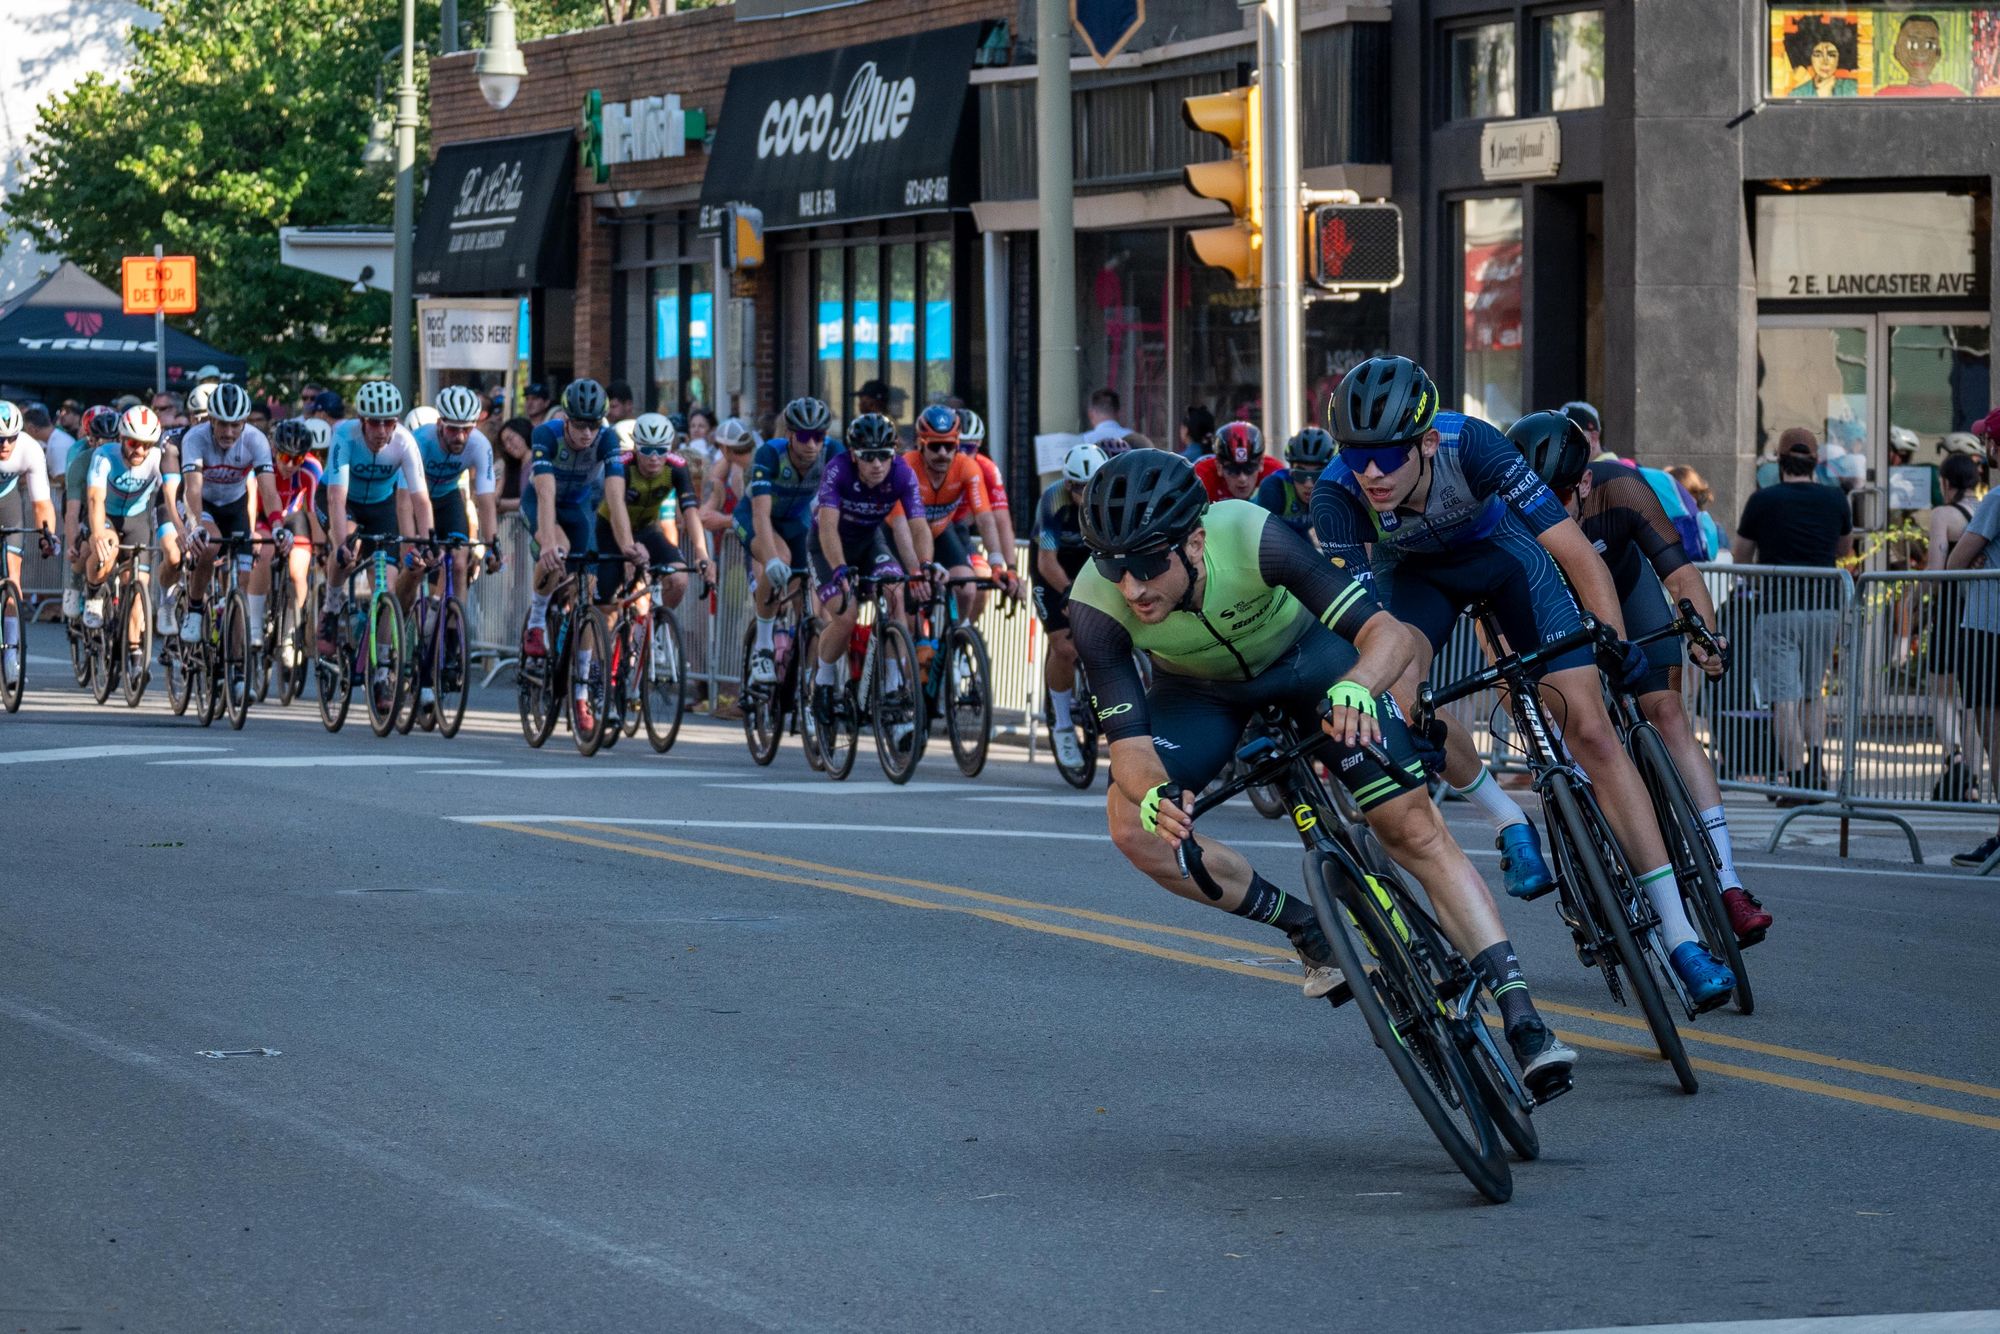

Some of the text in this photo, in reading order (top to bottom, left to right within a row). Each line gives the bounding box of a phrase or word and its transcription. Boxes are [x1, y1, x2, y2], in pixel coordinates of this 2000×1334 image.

[757, 61, 916, 161] coco Blue
[146, 267, 173, 282] END
[1788, 273, 1976, 294] 2 E. LANCASTER AVE
[133, 288, 186, 302] DETOUR
[450, 325, 485, 343] CROSS
[1413, 391, 1428, 424] LAZER
[1442, 497, 1464, 510] ELIEL
